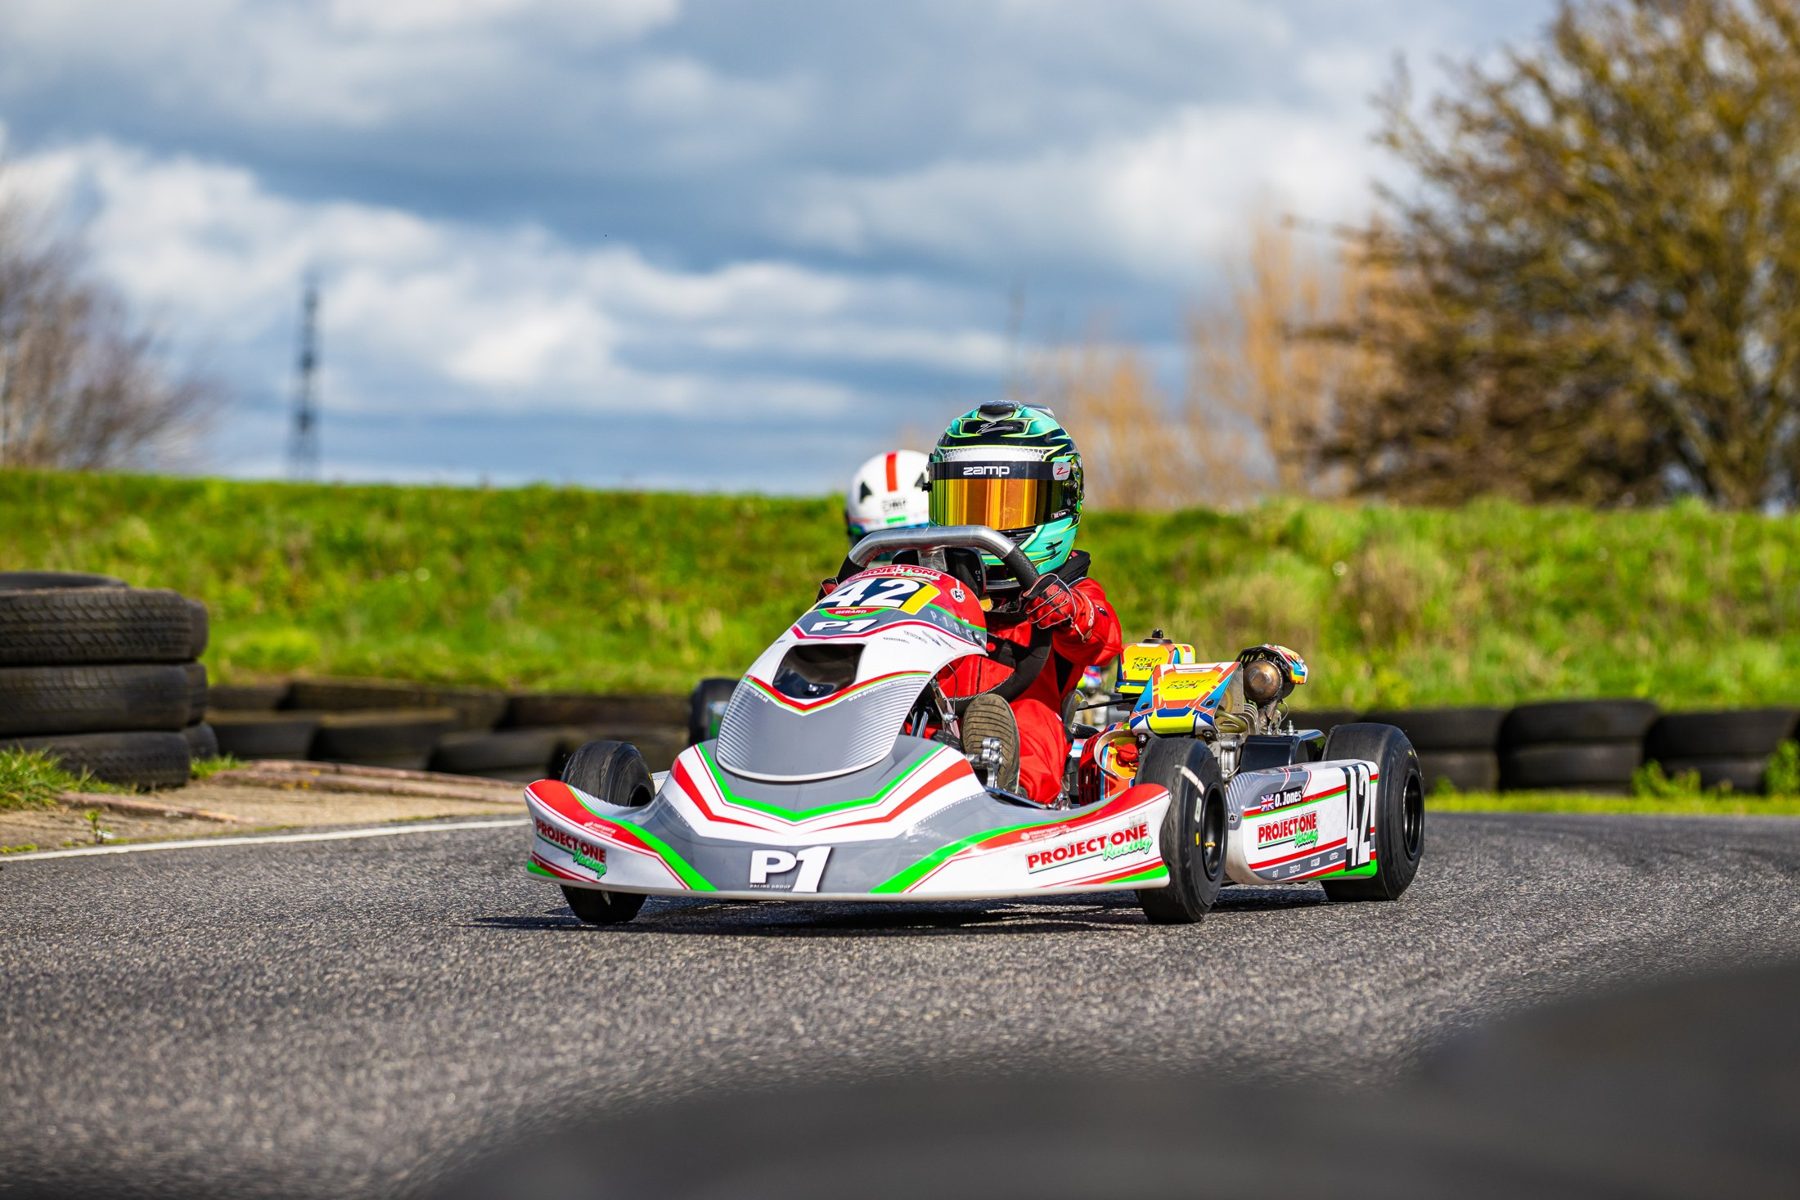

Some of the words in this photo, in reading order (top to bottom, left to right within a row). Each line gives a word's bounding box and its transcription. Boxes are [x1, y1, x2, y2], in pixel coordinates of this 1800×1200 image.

[963, 465, 1010, 477] zamp
[821, 578, 920, 608] 42
[809, 619, 877, 632] P1
[1283, 791, 1302, 805] Jones
[1259, 818, 1298, 843] PROJECT
[1299, 813, 1316, 832] ONE
[1346, 763, 1370, 867] 42
[535, 817, 578, 850] PROJECT
[581, 842, 606, 863] ONE
[1028, 836, 1107, 868] PROJECT
[1111, 824, 1148, 845] ONE
[1104, 837, 1153, 860] Racing
[749, 846, 832, 893] P1
